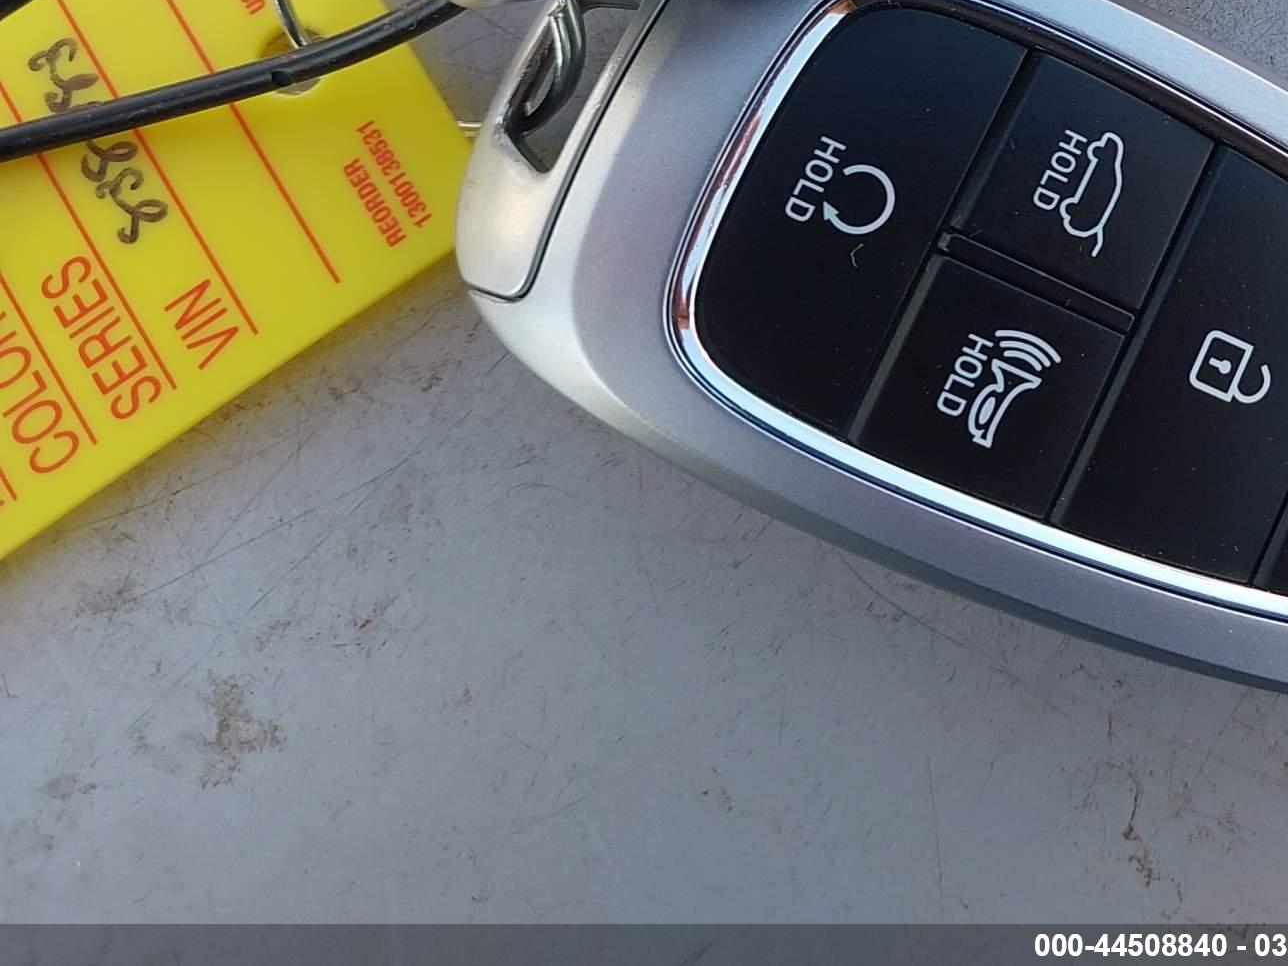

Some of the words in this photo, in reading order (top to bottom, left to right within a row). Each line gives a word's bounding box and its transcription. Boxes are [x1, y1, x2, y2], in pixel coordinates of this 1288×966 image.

[343, 157, 407, 247] REORDER
[356, 119, 432, 228] 1300138531
[785, 135, 847, 223] HOLD
[1033, 128, 1088, 212] HOLD
[41, 255, 162, 420] SERIES
[164, 278, 240, 370] VIN
[0, 311, 80, 474] COLO
[936, 332, 995, 417] HOLD
